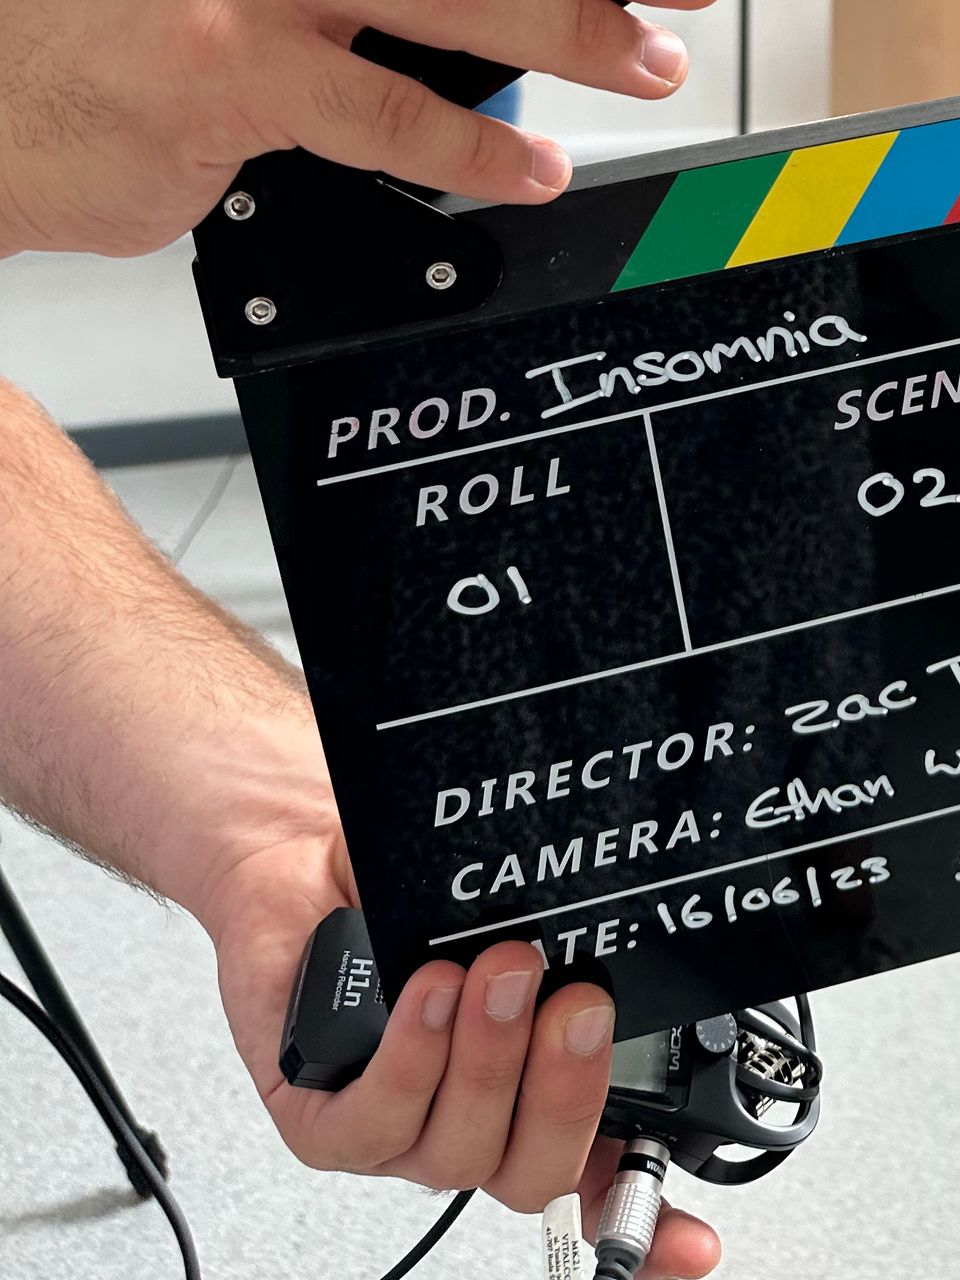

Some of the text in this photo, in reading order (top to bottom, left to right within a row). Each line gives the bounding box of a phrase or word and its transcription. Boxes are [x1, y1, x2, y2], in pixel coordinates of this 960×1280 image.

[327, 311, 868, 458] PROD. Insomnia
[415, 457, 571, 526] ROLL
[446, 565, 532, 616] 01
[434, 722, 755, 827] DIRECTOR:
[451, 809, 722, 901] CAMERA:
[745, 775, 896, 828] Ethan
[332, 950, 350, 1011] Handy Recorder
[344, 959, 373, 1006] H1n
